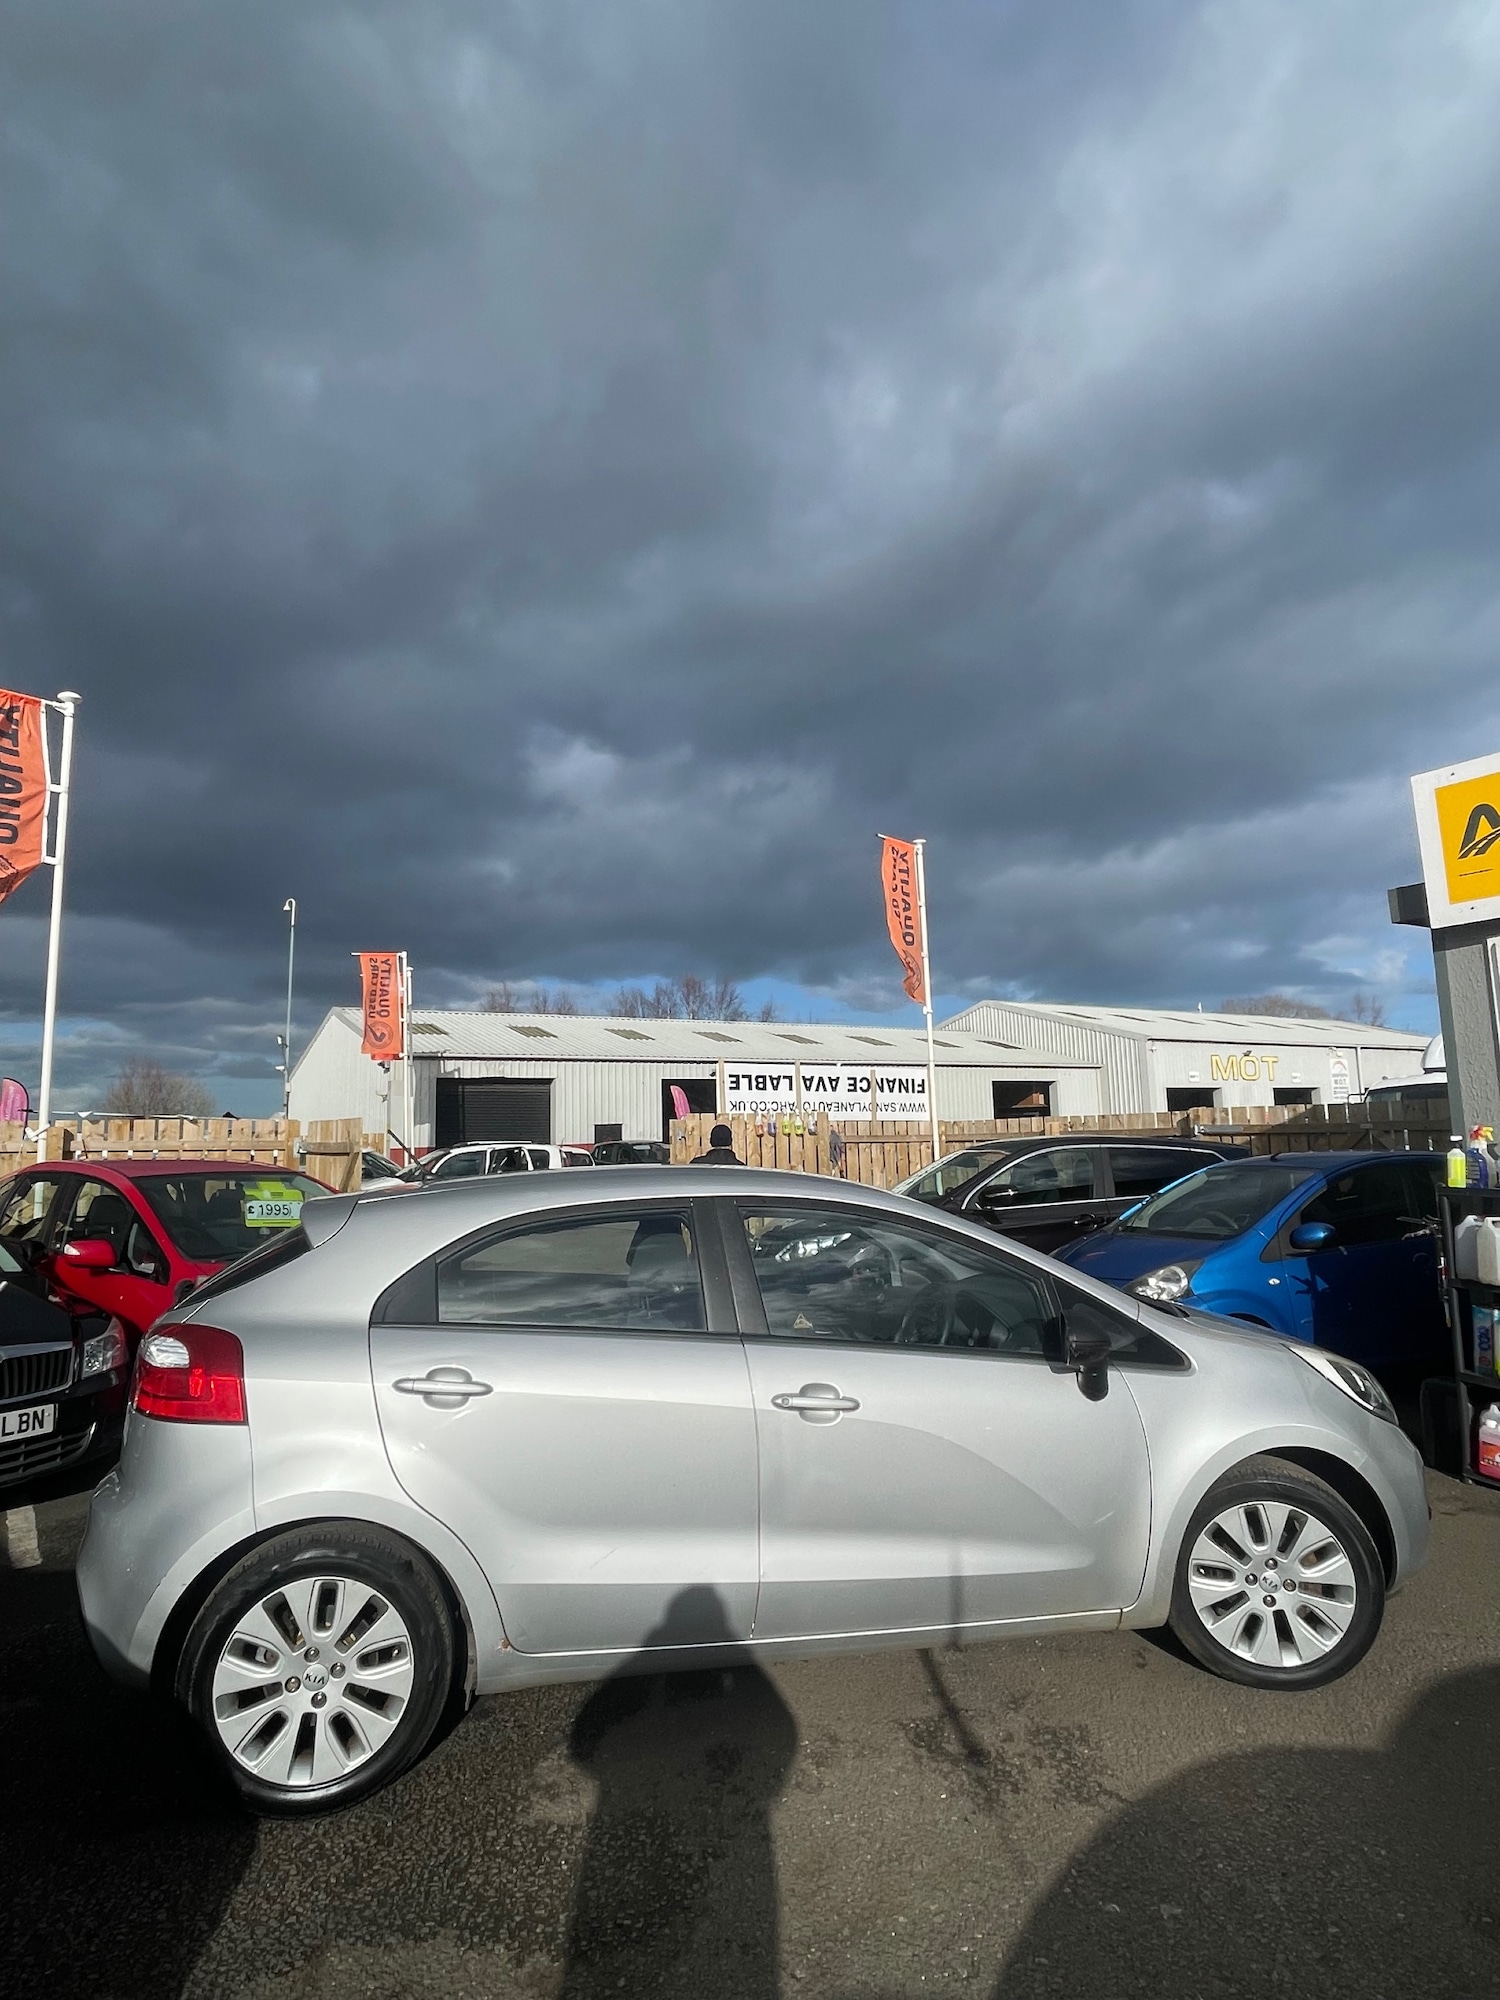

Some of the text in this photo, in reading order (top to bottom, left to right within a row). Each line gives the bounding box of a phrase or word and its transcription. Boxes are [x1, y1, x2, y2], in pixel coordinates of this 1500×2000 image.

[1211, 1054, 1279, 1081] MOT
[728, 1074, 926, 1093] FINANCE AVALABLE
[1, 1409, 45, 1437] LBN
[1262, 1576, 1278, 1591] KIA
[304, 1673, 325, 1685] KIA
